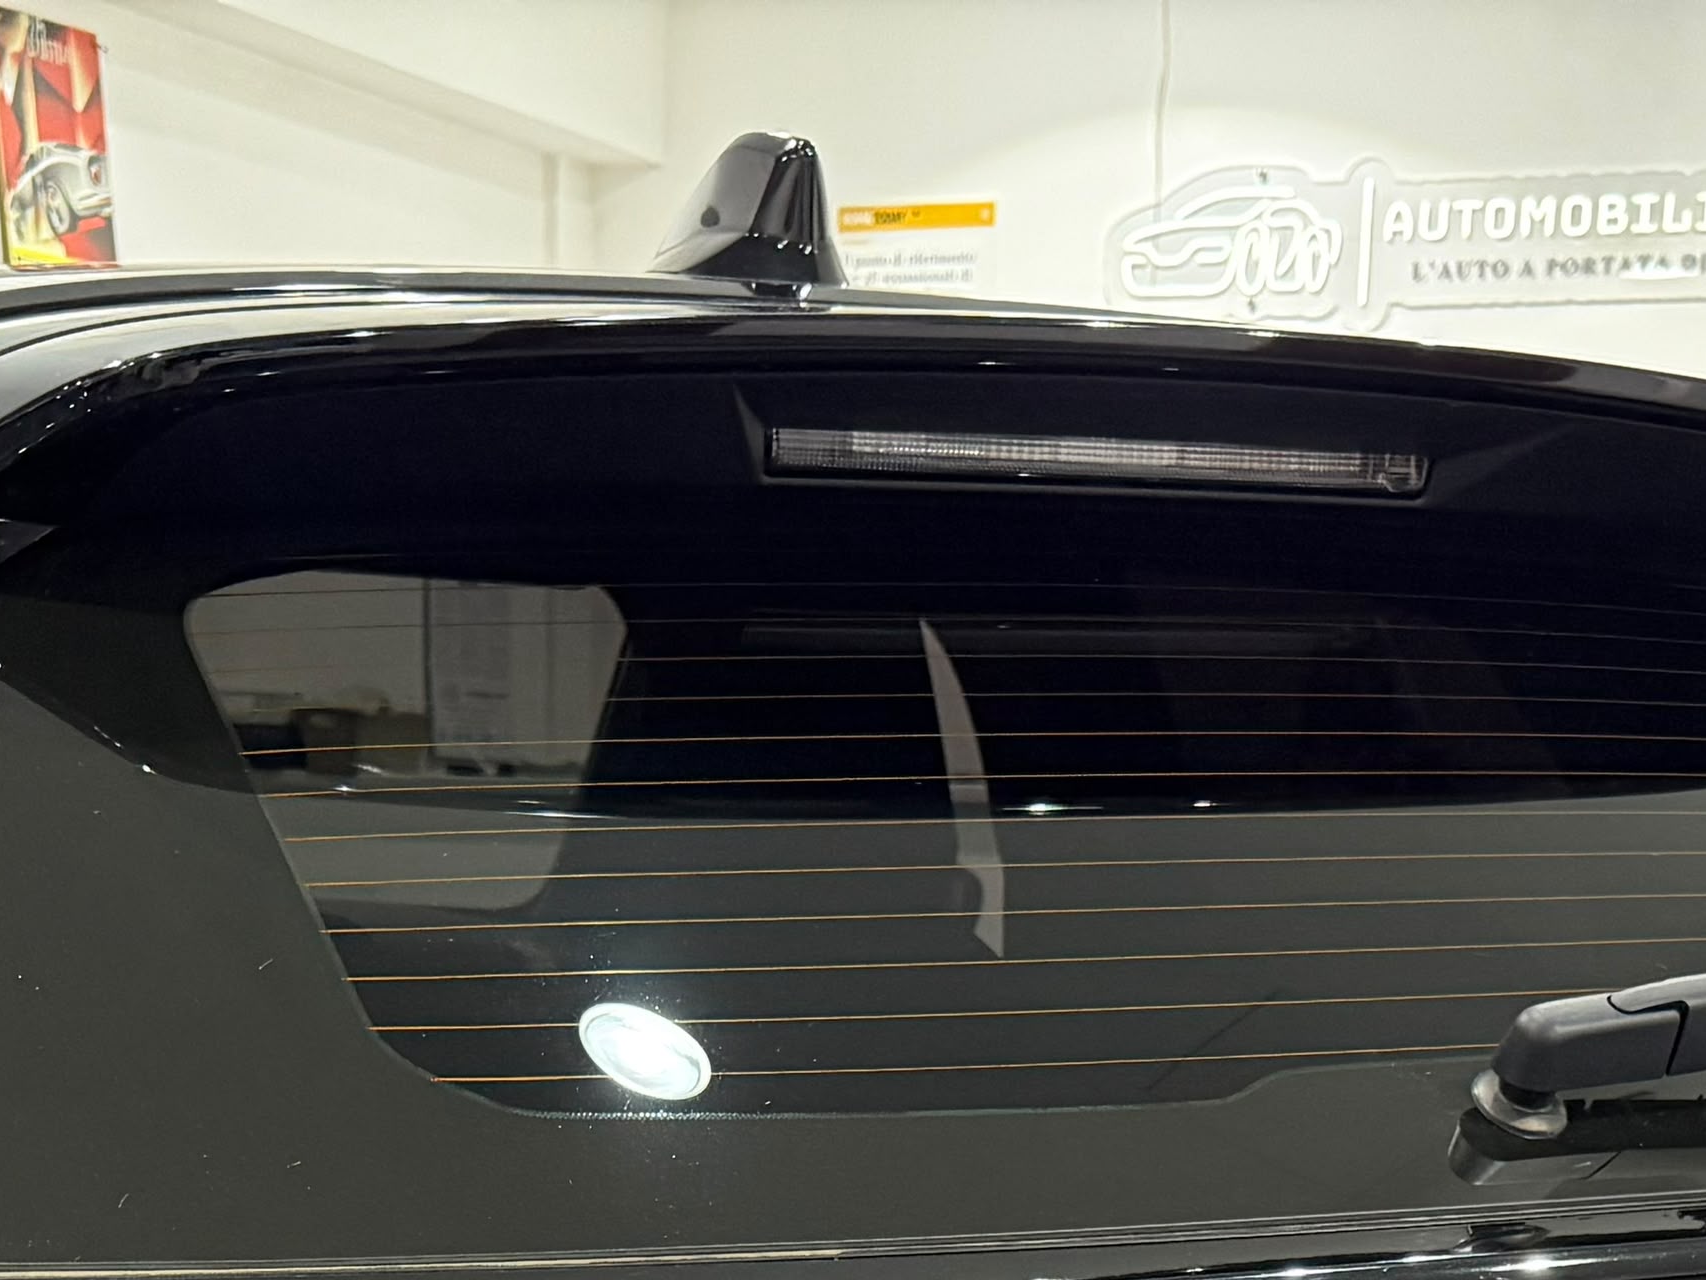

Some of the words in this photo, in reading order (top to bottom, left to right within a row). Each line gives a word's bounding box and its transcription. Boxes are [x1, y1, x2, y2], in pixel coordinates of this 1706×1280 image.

[1410, 256, 1510, 283] L'AUTO
[1519, 256, 1536, 279] A
[1545, 252, 1671, 278] PORTATA
